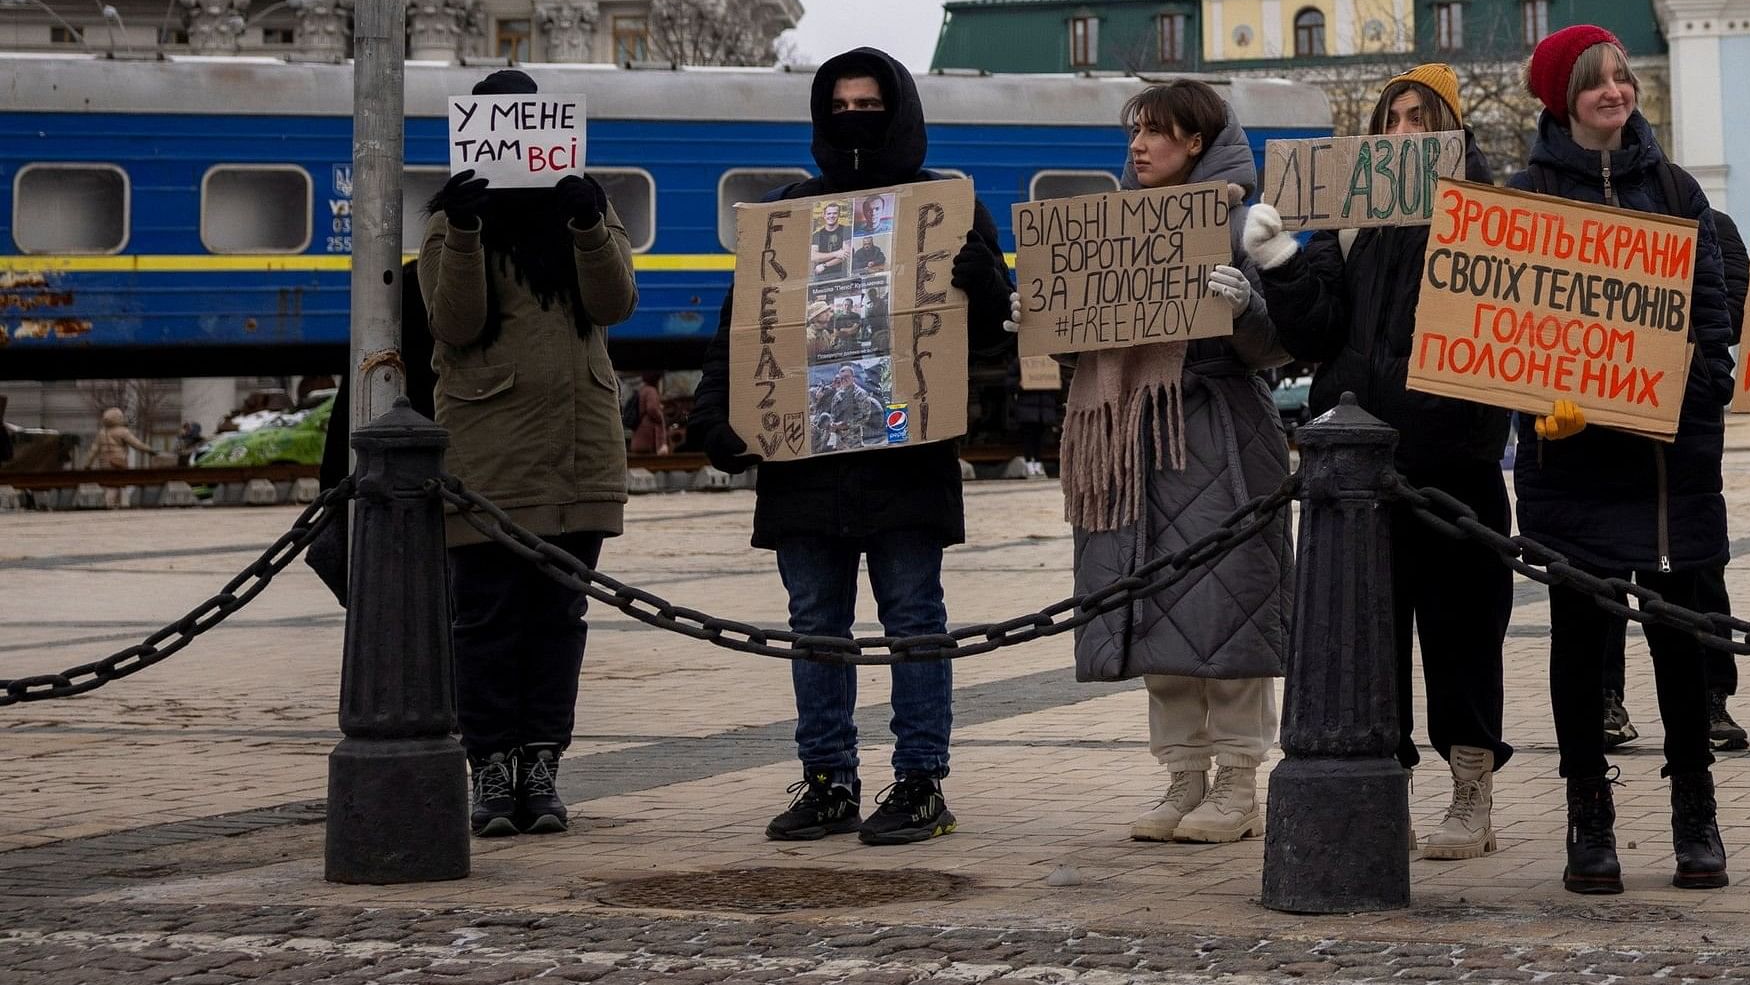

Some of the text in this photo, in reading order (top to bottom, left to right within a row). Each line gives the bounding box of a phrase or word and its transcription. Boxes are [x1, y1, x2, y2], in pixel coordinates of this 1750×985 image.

[454, 102, 576, 132] У МЕНЕ
[454, 139, 522, 163] ТАМ
[1273, 144, 1333, 226] ДЕ
[1019, 188, 1228, 247] ВІЛЬНІ МУСЯТЬ
[1436, 189, 1692, 280] ЗРОБІТЬ ЕКРАНИ
[1051, 232, 1184, 274] БОРОТИСЯ
[1029, 262, 1232, 313] ЗА ПОЛОНЕНИ
[1427, 248, 1687, 332] СВОЇХ ТЕЛЕФОНІВ
[1055, 300, 1199, 344] #FREEAZOV
[1473, 303, 1635, 363] ГОЛОСОМ
[1418, 333, 1665, 407] ПОЛОНЕНИХ
